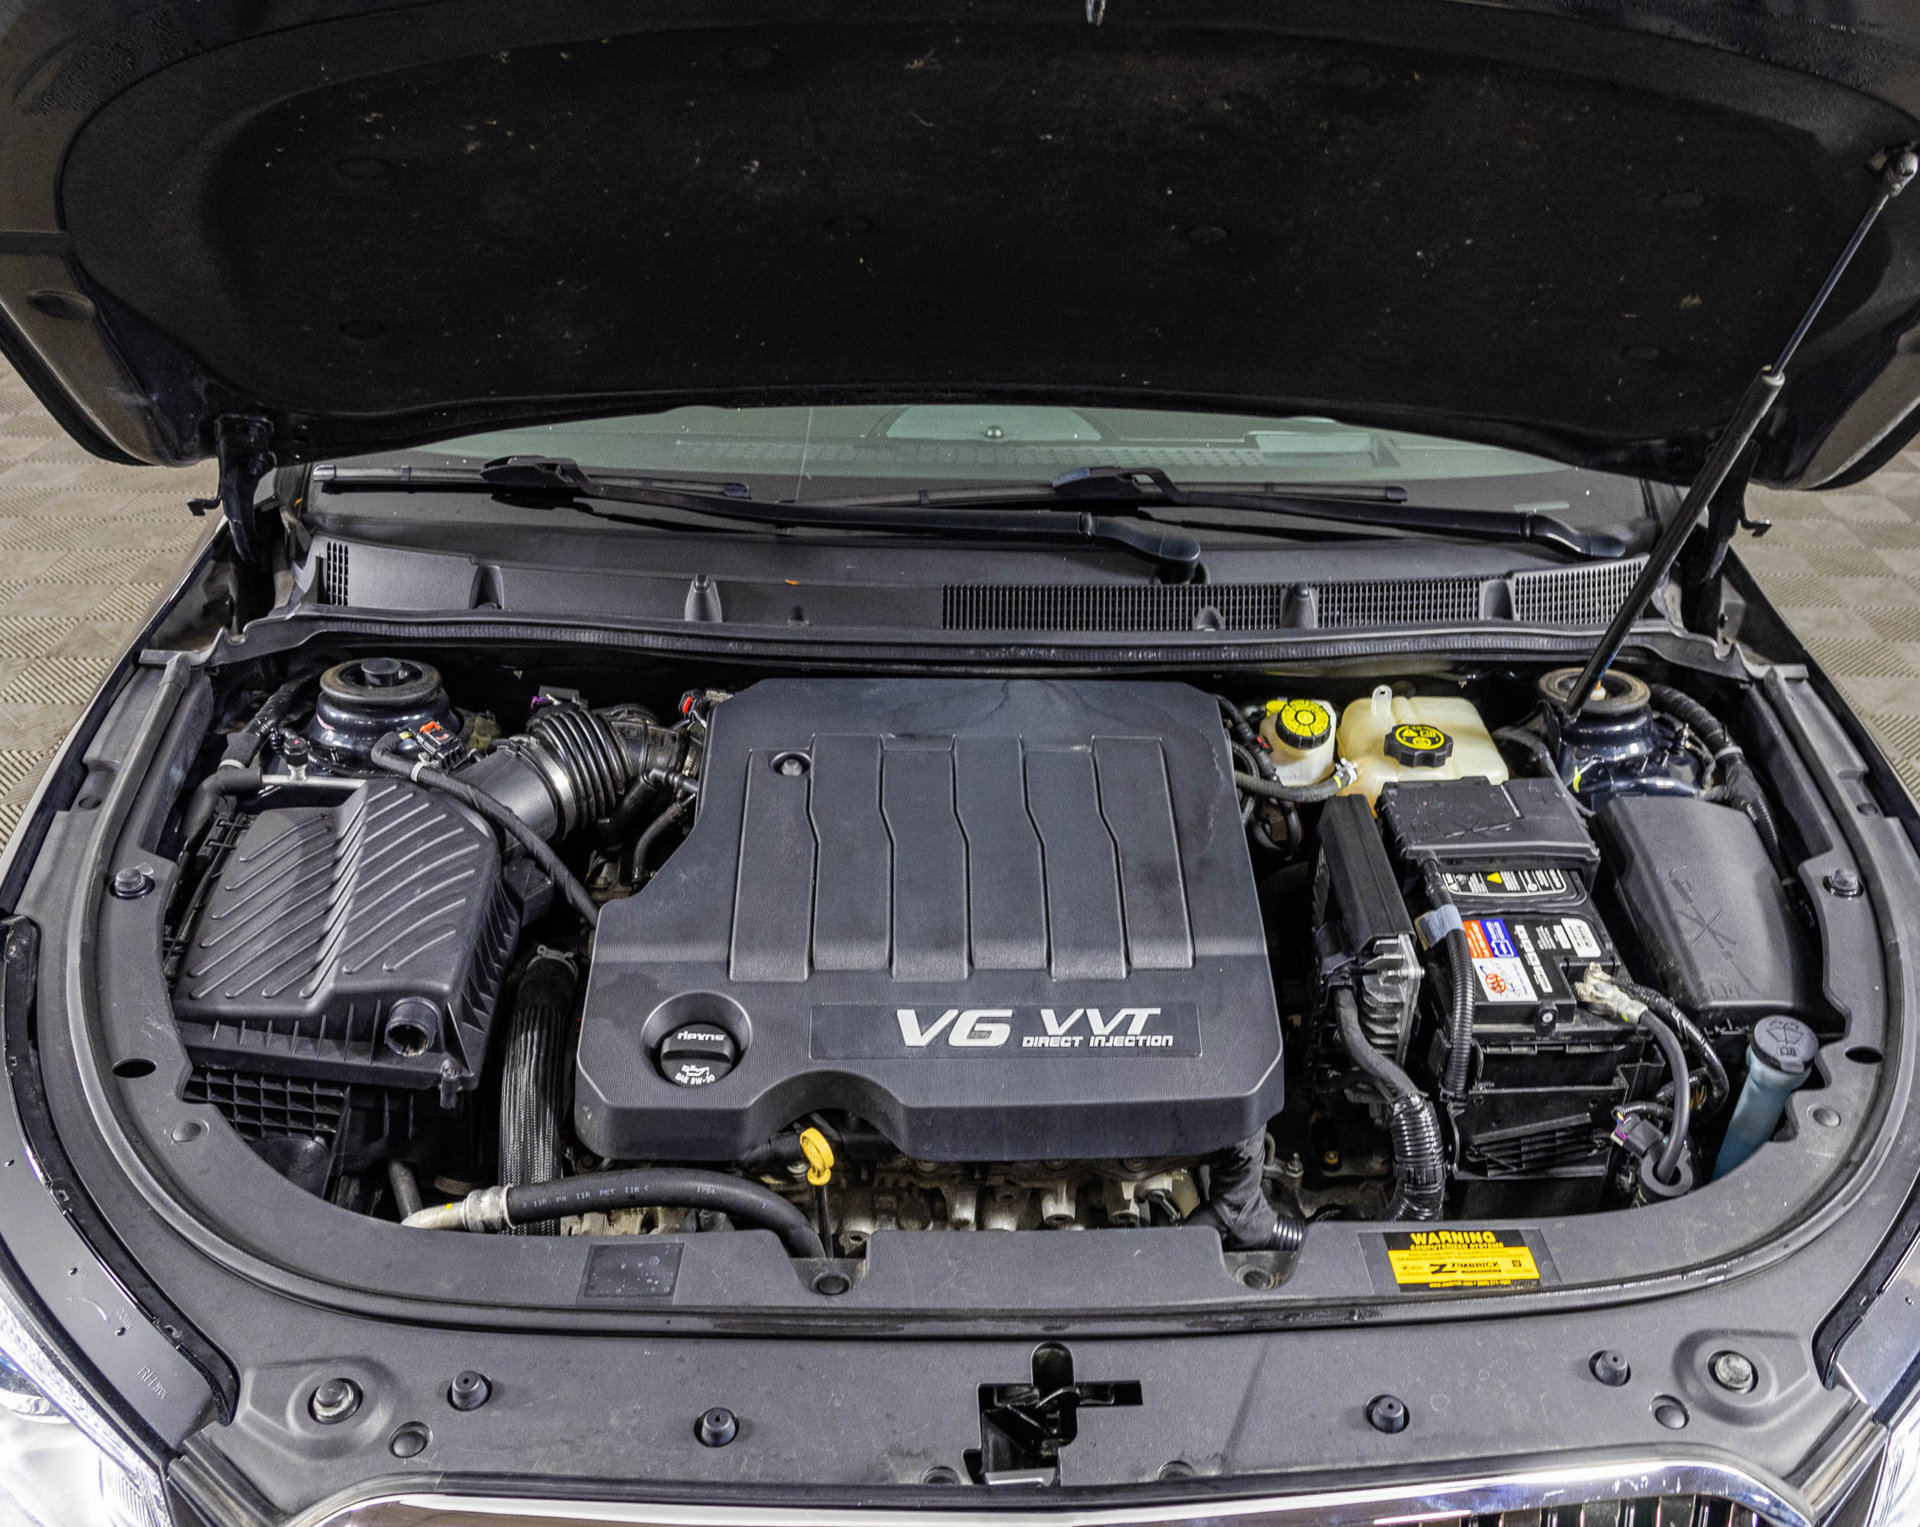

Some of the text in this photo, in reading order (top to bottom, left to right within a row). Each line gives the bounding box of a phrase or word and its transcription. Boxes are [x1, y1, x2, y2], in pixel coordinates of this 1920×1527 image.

[897, 1007, 1161, 1048] V6 VVT
[1022, 1034, 1173, 1048] DIRECT INJECTION
[1410, 1231, 1497, 1245] WARNING
